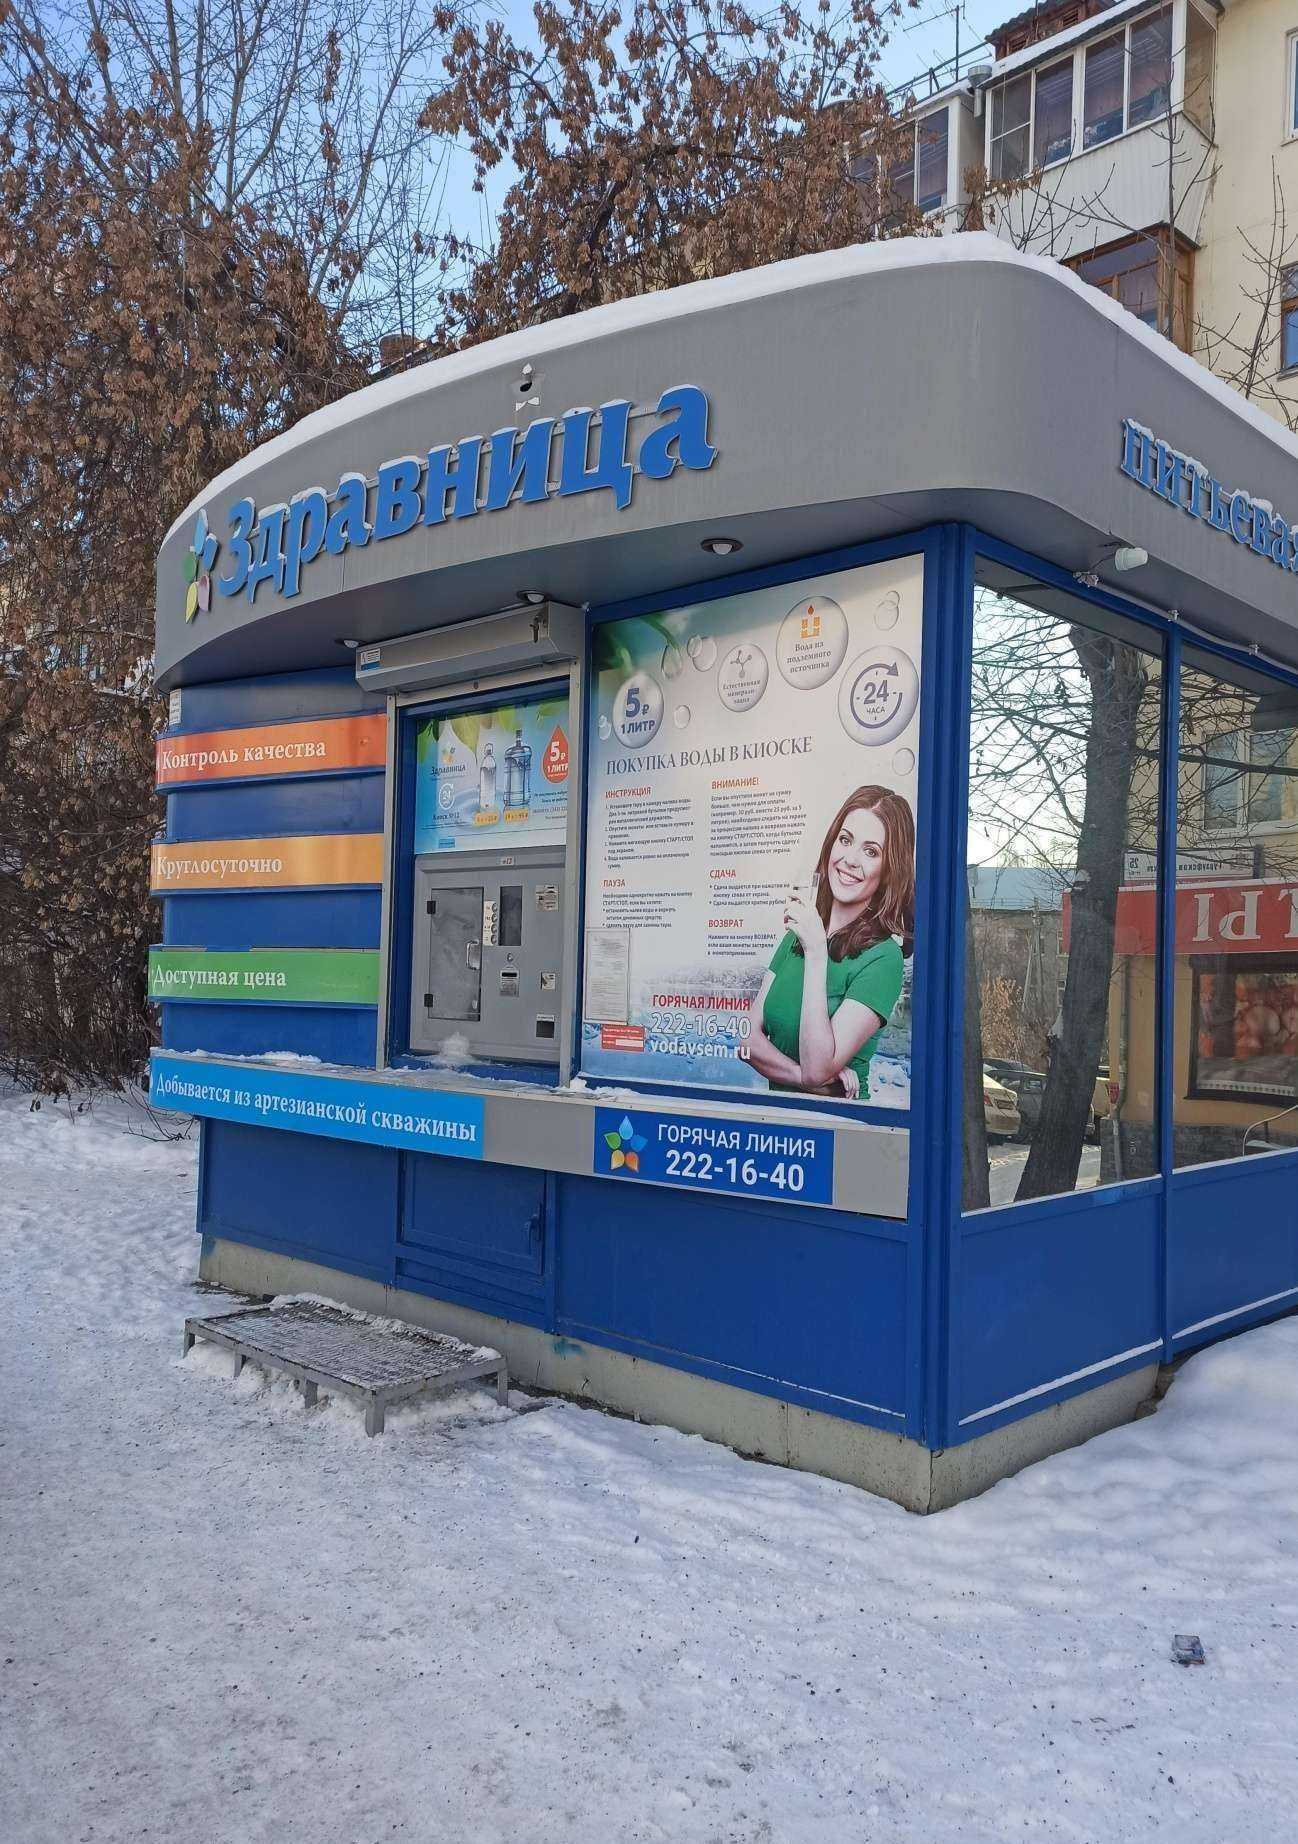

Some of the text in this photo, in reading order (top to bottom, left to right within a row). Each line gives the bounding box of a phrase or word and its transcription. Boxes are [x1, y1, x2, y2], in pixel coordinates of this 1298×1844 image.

[217, 384, 718, 603] Здравница
[787, 650, 831, 664] подземного
[795, 641, 824, 652] Вода из
[790, 661, 829, 674] источника
[625, 687, 640, 718] 5
[863, 680, 889, 705] 24
[866, 706, 886, 716] ЧАСА
[162, 741, 326, 770] Контроль качества
[550, 741, 560, 762] 5
[606, 736, 812, 775] ПОКУПКА ВОДЫ В КИОСКЕ
[605, 787, 651, 798] ИНСТРУКЦИЯ
[711, 777, 759, 789] ВНИМАНИЕ!
[157, 855, 282, 879] Круглосуточно
[709, 869, 736, 879] СДАЧА
[603, 879, 626, 888] ПАУЗА
[708, 919, 744, 928] ВОЗВРАТ
[153, 964, 286, 991] Доступная цена
[652, 994, 750, 1011] ГОРЯЧАЯ ЛИНИЯ
[650, 1012, 750, 1039] 222-16-40
[156, 1073, 476, 1142] Добывается из артезианской скважины
[658, 1123, 815, 1159] ГОРЯЧАЯ ЛИНИЯ
[665, 1149, 804, 1192] 222-16-40
